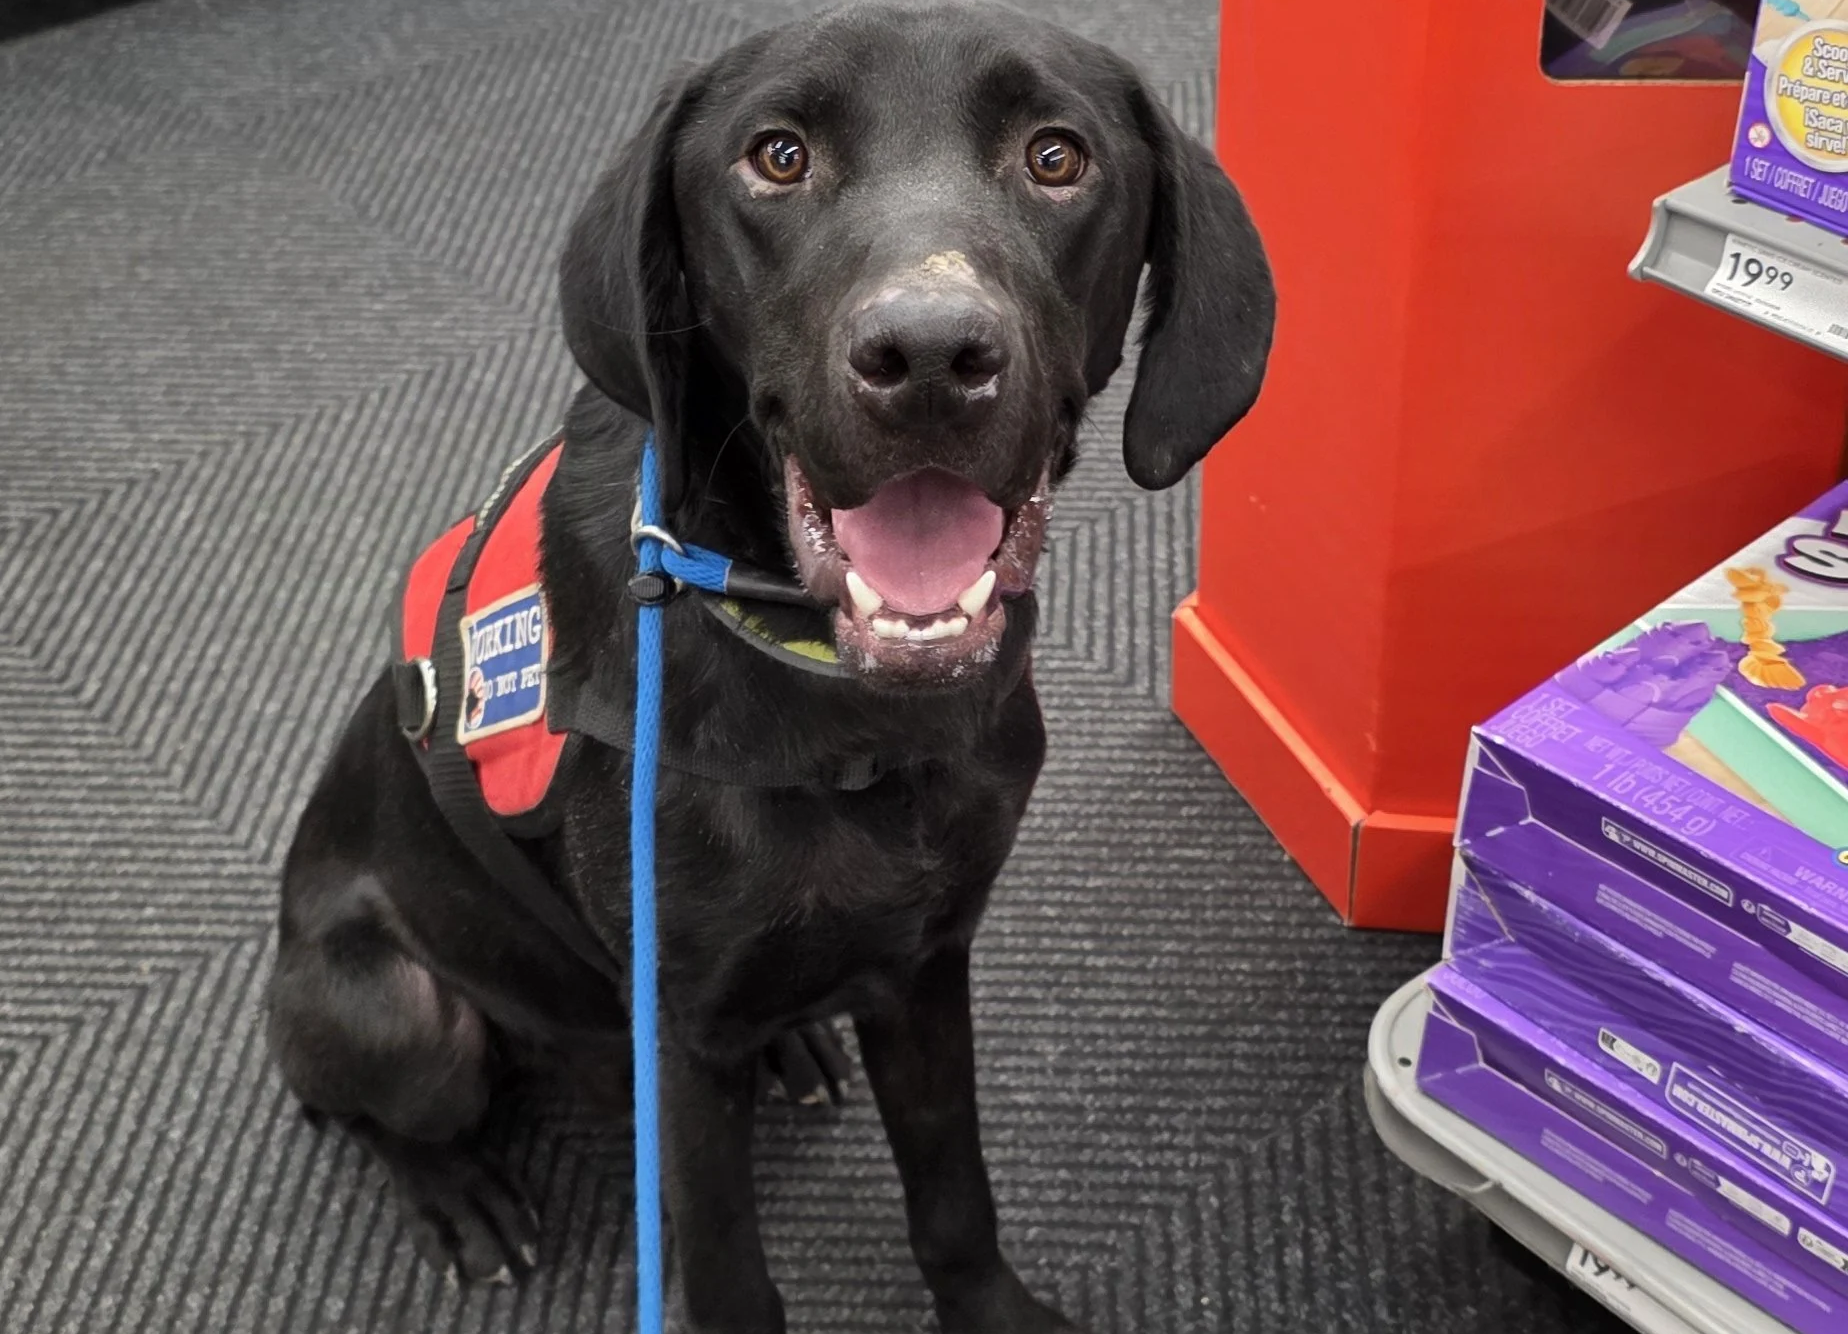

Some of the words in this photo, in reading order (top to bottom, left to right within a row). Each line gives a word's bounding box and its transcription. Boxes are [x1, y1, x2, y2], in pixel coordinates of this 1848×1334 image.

[1803, 57, 1814, 77] &
[1778, 75, 1831, 106] Prépare
[1832, 89, 1848, 108] et
[1806, 130, 1847, 155] sirve!
[1751, 158, 1770, 182] SET
[1774, 166, 1814, 198] COFFRET
[496, 671, 518, 697] NOT
[520, 663, 541, 689] PET
[1548, 696, 1582, 719] SET
[1592, 763, 1613, 782] 1
[1606, 770, 1636, 795] lb
[1631, 783, 1692, 823] (454
[1680, 816, 1718, 837] g)
